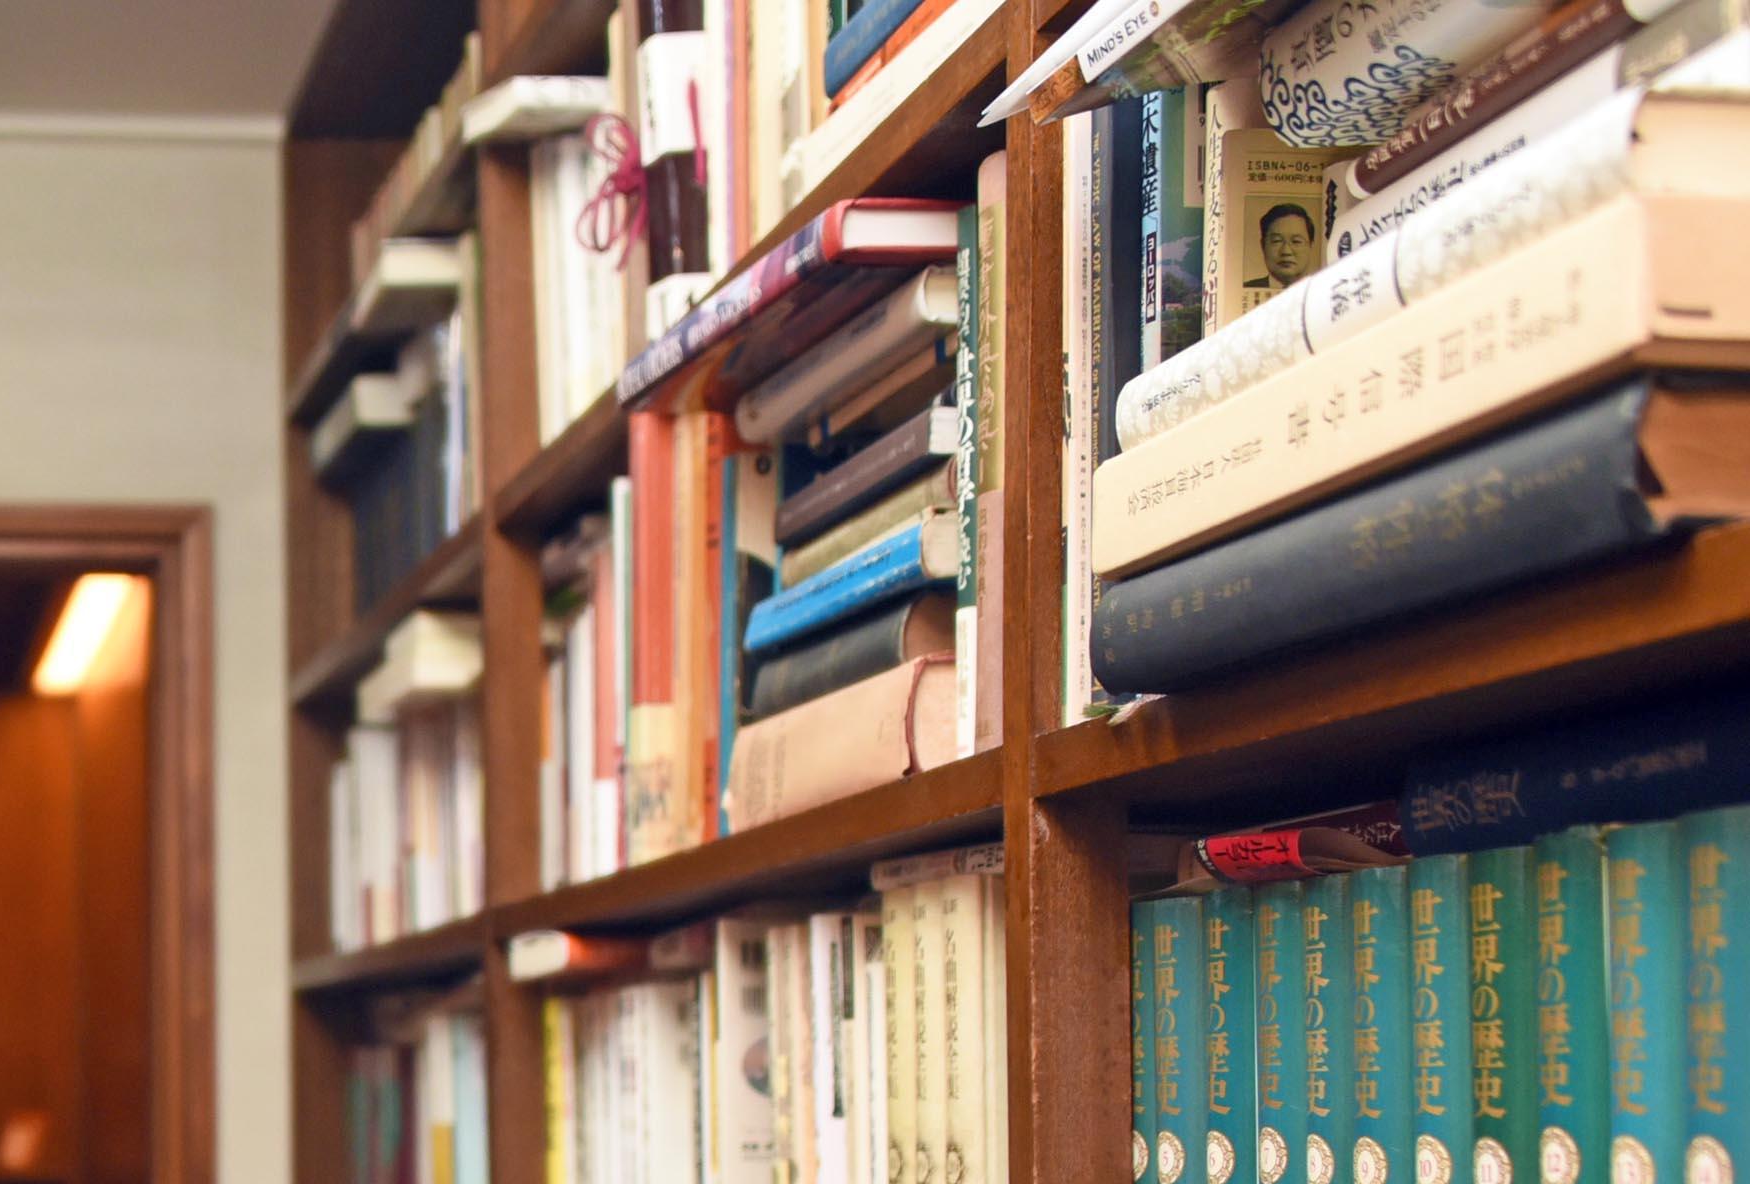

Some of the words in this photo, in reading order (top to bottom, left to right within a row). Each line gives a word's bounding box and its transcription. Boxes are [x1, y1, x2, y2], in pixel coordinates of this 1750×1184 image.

[1087, 33, 1123, 66] MIND'S
[1124, 12, 1149, 35] EYE
[1092, 159, 1100, 206] VEDIC
[1092, 252, 1100, 272] OF
[1092, 279, 1100, 366] MARRIAGE
[1154, 925, 1180, 1115] 世界の歴史
[1208, 918, 1231, 1116] 世界の歴史
[1258, 904, 1283, 1110] 世界の歴史
[1306, 906, 1330, 1117] 世界の歴史
[1353, 900, 1382, 1119] 世界の歴史
[1412, 889, 1446, 1115] 世界の歴史
[1470, 882, 1506, 1118] 世界の歴史
[1538, 861, 1573, 1107] 世界の歴史
[1611, 858, 1648, 1116] 世界の歴史
[1689, 843, 1730, 1116] 世界の歴史
